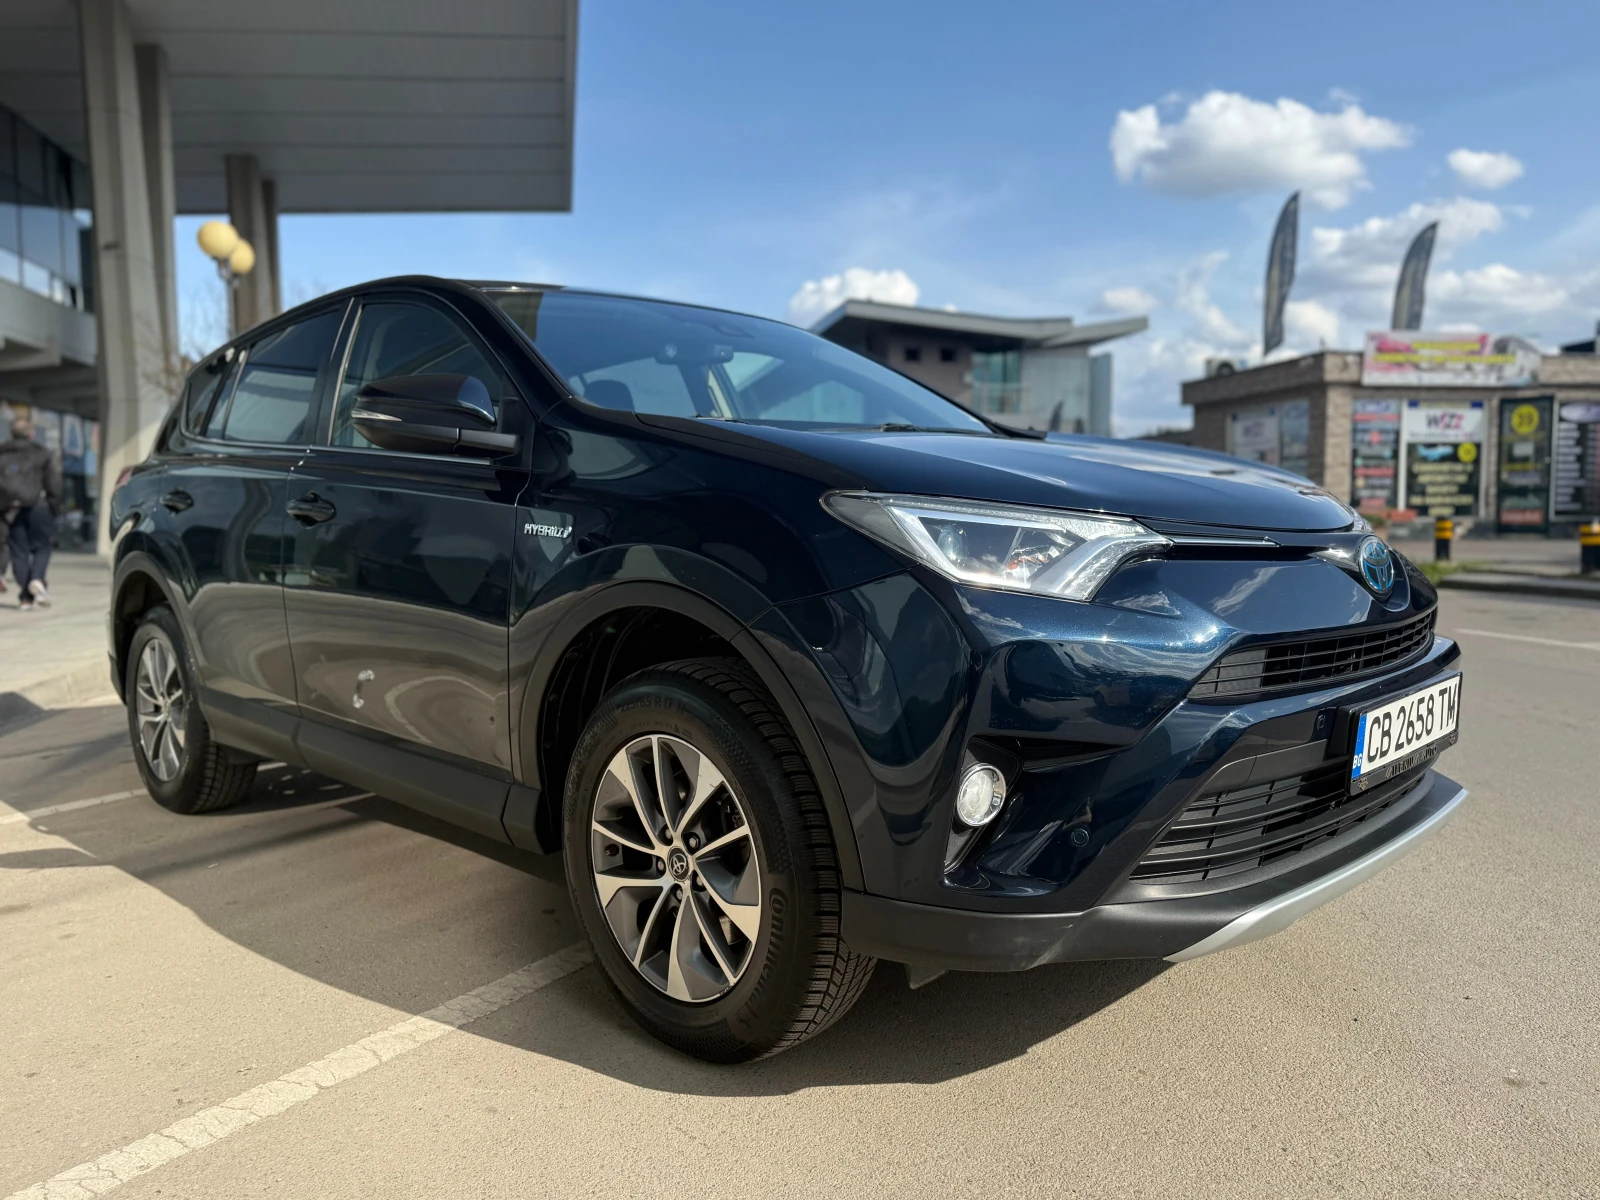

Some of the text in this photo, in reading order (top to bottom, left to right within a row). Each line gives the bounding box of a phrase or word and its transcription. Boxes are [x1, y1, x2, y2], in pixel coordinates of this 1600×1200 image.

[523, 523, 564, 538] HYBRID
[1367, 682, 1457, 763] CB 2658 TM
[1352, 753, 1363, 769] BG
